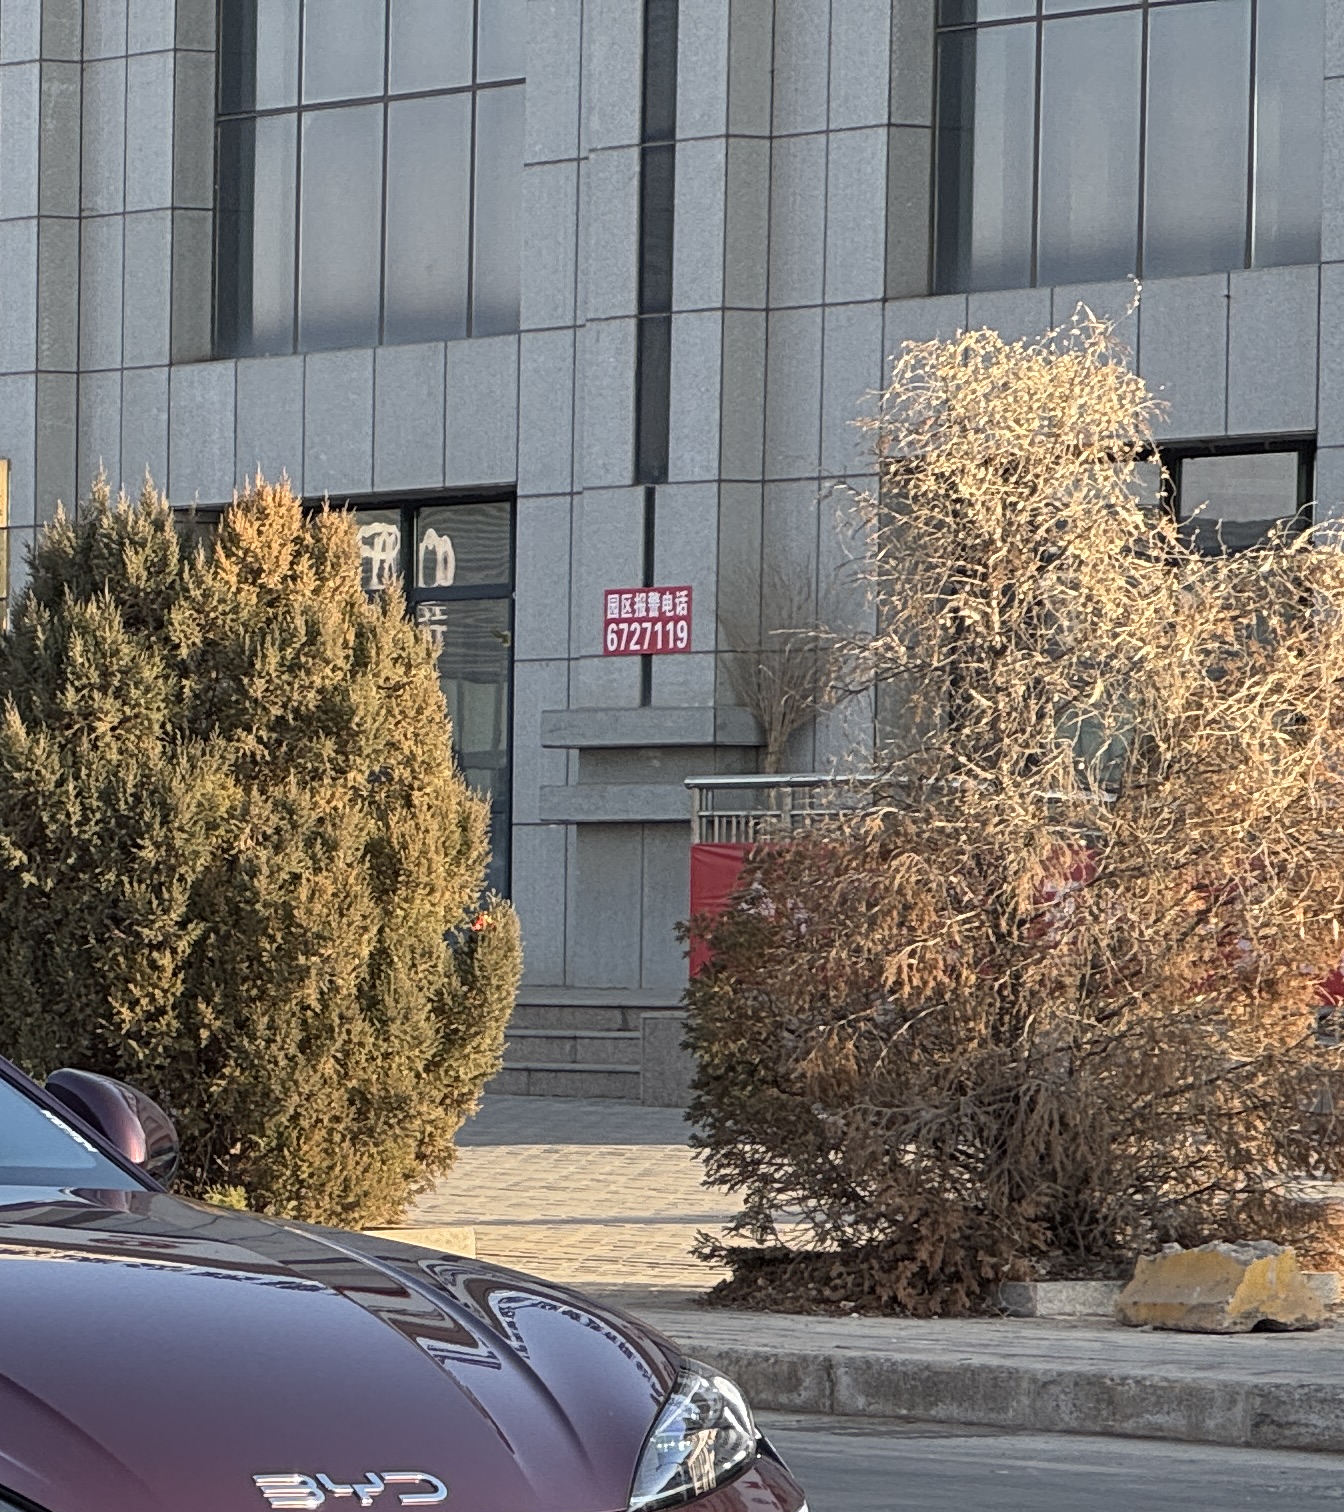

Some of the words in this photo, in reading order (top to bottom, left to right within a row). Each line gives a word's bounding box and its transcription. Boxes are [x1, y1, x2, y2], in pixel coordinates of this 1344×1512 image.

[606, 590, 689, 620] 园区报警电话
[606, 620, 688, 652] 6727119
[253, 1472, 448, 1509] BYD
